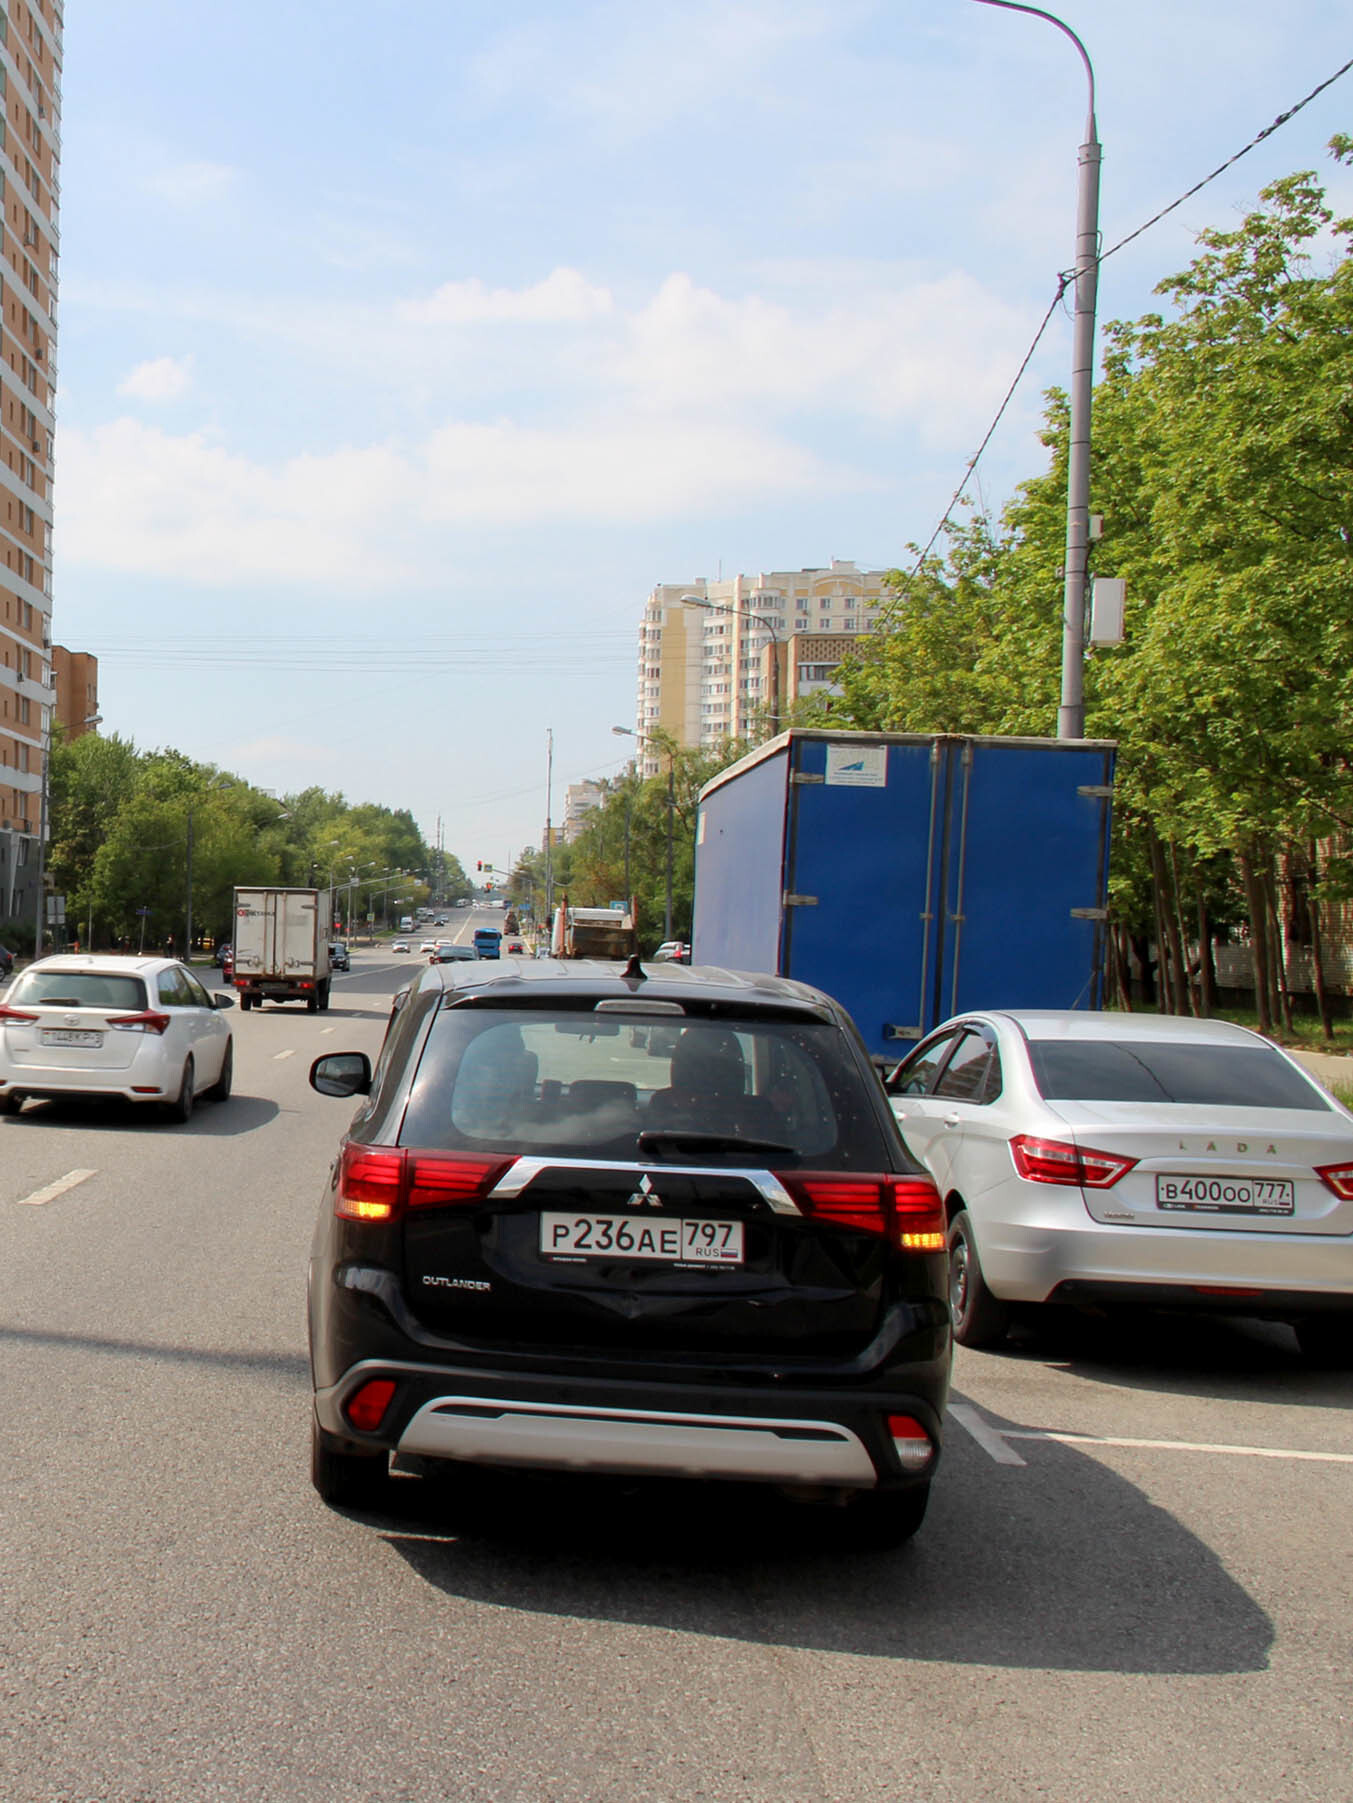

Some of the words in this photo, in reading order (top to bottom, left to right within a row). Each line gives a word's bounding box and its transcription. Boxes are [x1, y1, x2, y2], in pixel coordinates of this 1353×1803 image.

[1179, 1141, 1277, 1154] LADA
[1254, 1182, 1286, 1199] 777
[553, 1218, 679, 1254] Р236АЕ
[685, 1222, 733, 1248] 797
[695, 1247, 720, 1258] RUS
[422, 1275, 491, 1291] OUTLANDER
